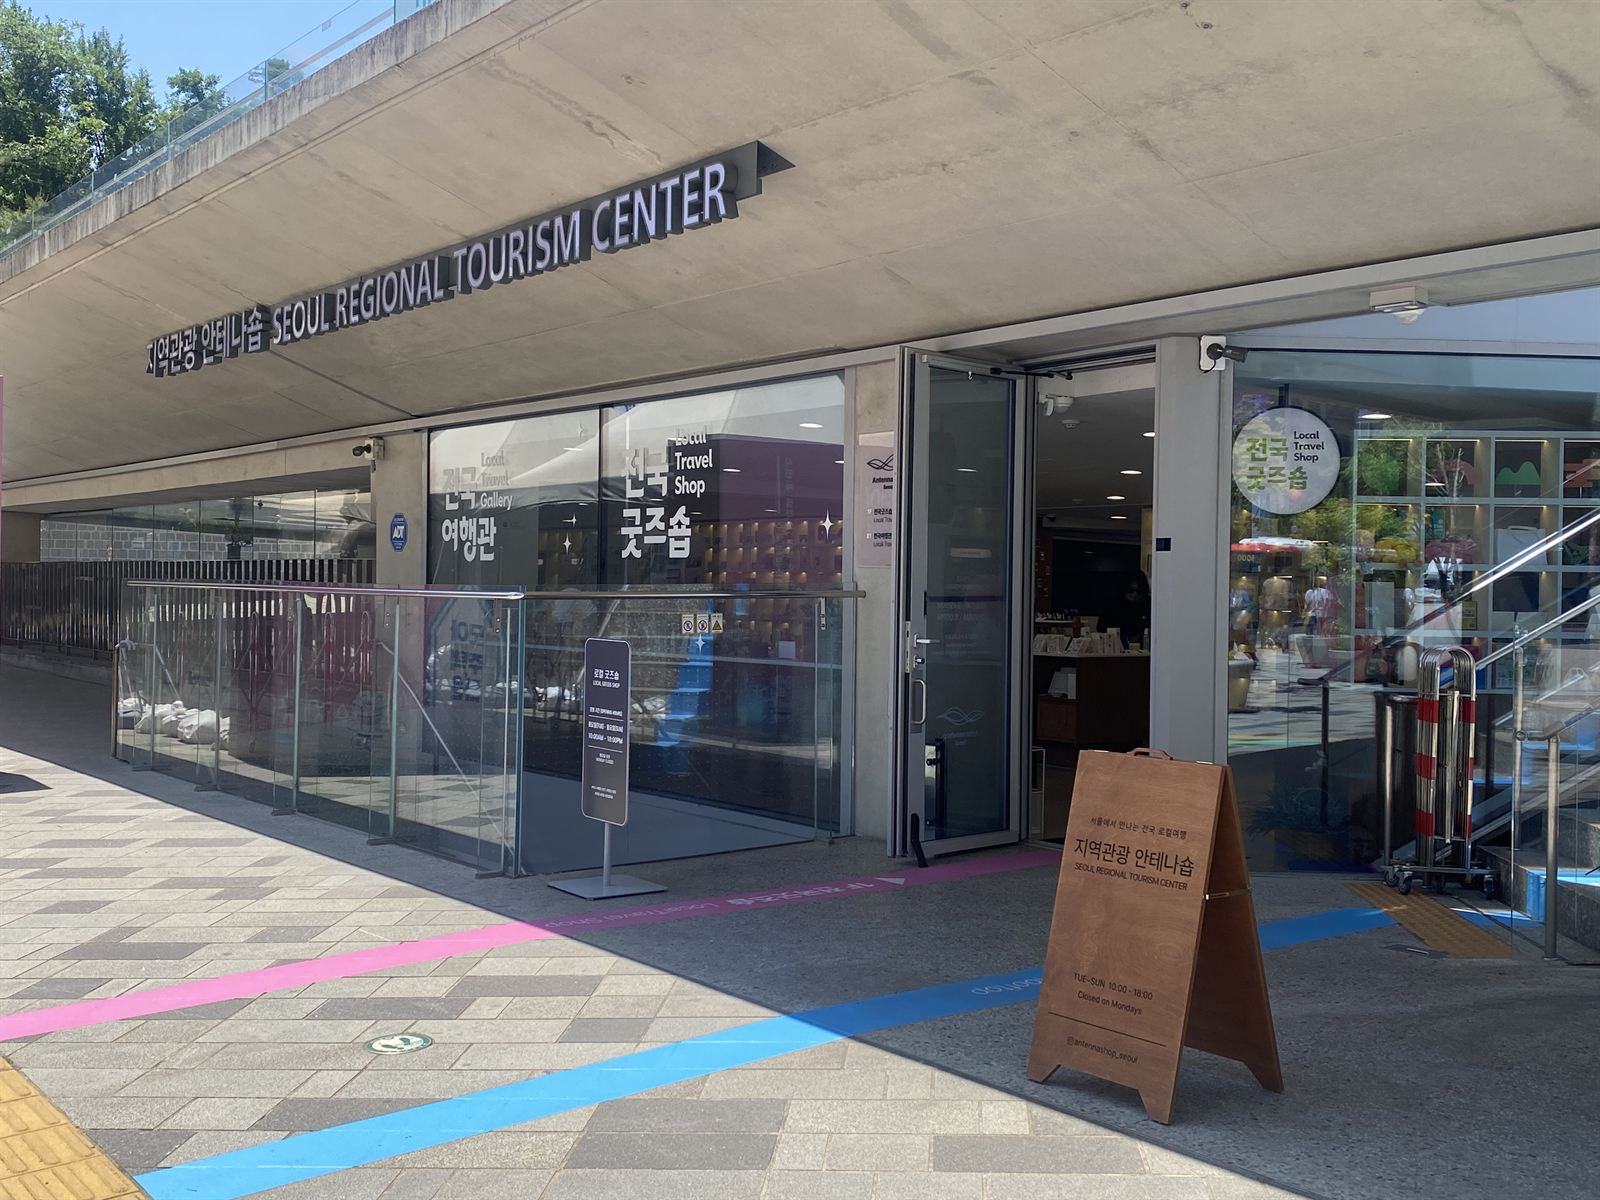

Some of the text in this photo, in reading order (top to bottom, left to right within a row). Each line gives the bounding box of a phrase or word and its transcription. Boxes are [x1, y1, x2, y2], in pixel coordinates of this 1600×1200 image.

[145, 162, 726, 377] 지역관광 안테나숍 SEOUL REGIONAL TOURISM CENTER
[675, 425, 707, 446] Local
[1293, 431, 1319, 440] Local
[1293, 441, 1324, 450] Travel
[481, 450, 504, 467] Local
[674, 449, 713, 470] Travel
[1247, 437, 1288, 462] 전국
[1293, 453, 1319, 463] Shop
[481, 470, 508, 486] Travel
[621, 447, 669, 498] 전국
[1247, 466, 1308, 490] 굿즈숍
[443, 467, 477, 511] 전국
[674, 475, 705, 498] Shop
[480, 492, 512, 511] Gallery
[441, 515, 497, 562] 여행관
[620, 505, 691, 558] 굿즈숍
[594, 668, 619, 681] 로컬 굿즈숍
[1118, 821, 1139, 832] 만나는
[1142, 824, 1156, 836] 전국
[1157, 827, 1187, 840] 로컬여행
[1074, 838, 1195, 877] 지역관광 안테나숍
[1075, 862, 1187, 891] SEOUL REGIONAL TOURISM CENTER
[1077, 990, 1142, 1015] Closed on Mondays
